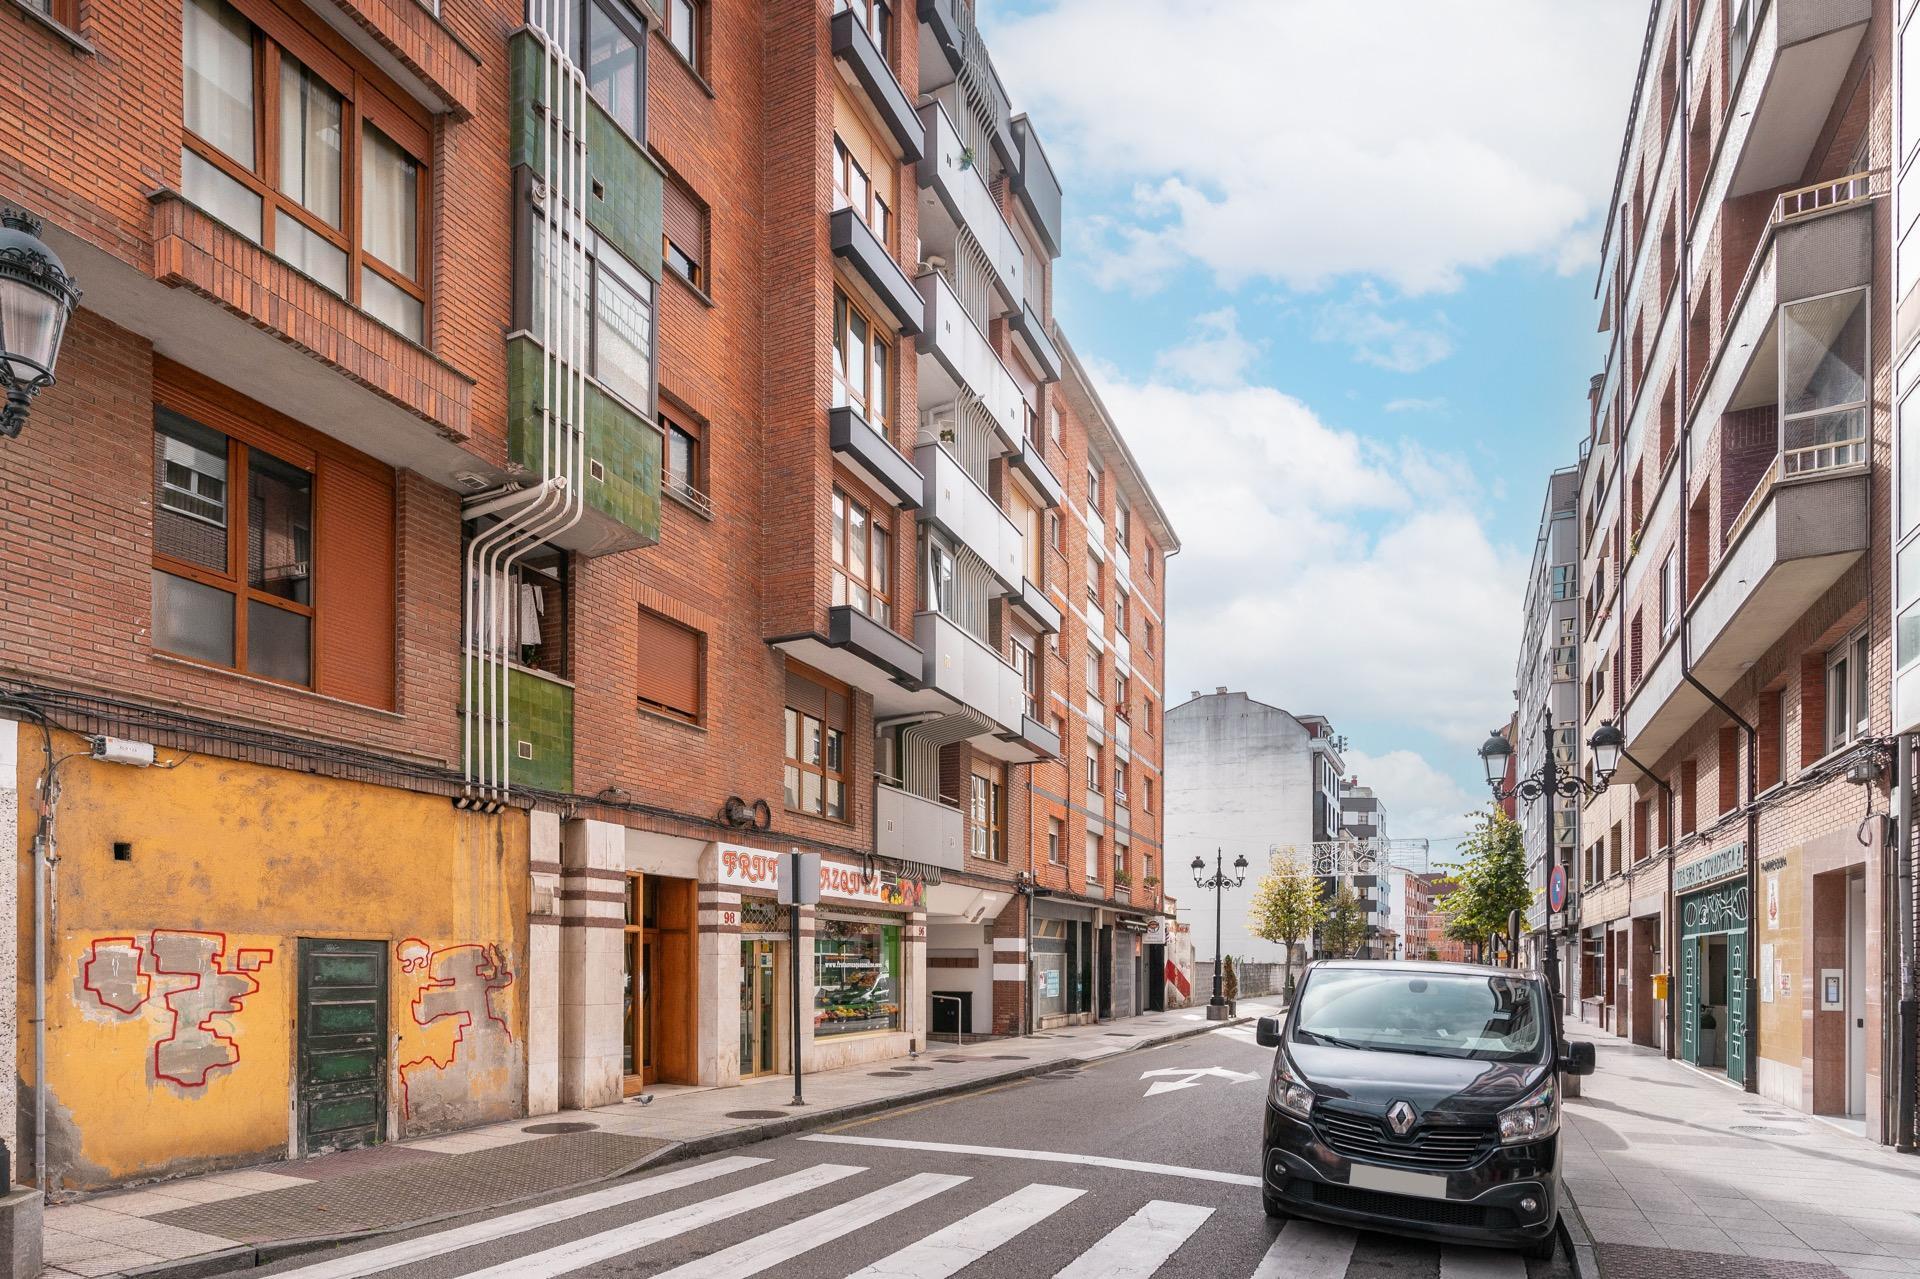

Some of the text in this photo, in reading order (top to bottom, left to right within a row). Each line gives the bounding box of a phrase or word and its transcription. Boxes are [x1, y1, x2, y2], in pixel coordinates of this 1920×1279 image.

[722, 850, 879, 896] FRUT AZQUEZ
[723, 912, 735, 924] 98
[918, 926, 925, 936] 96
